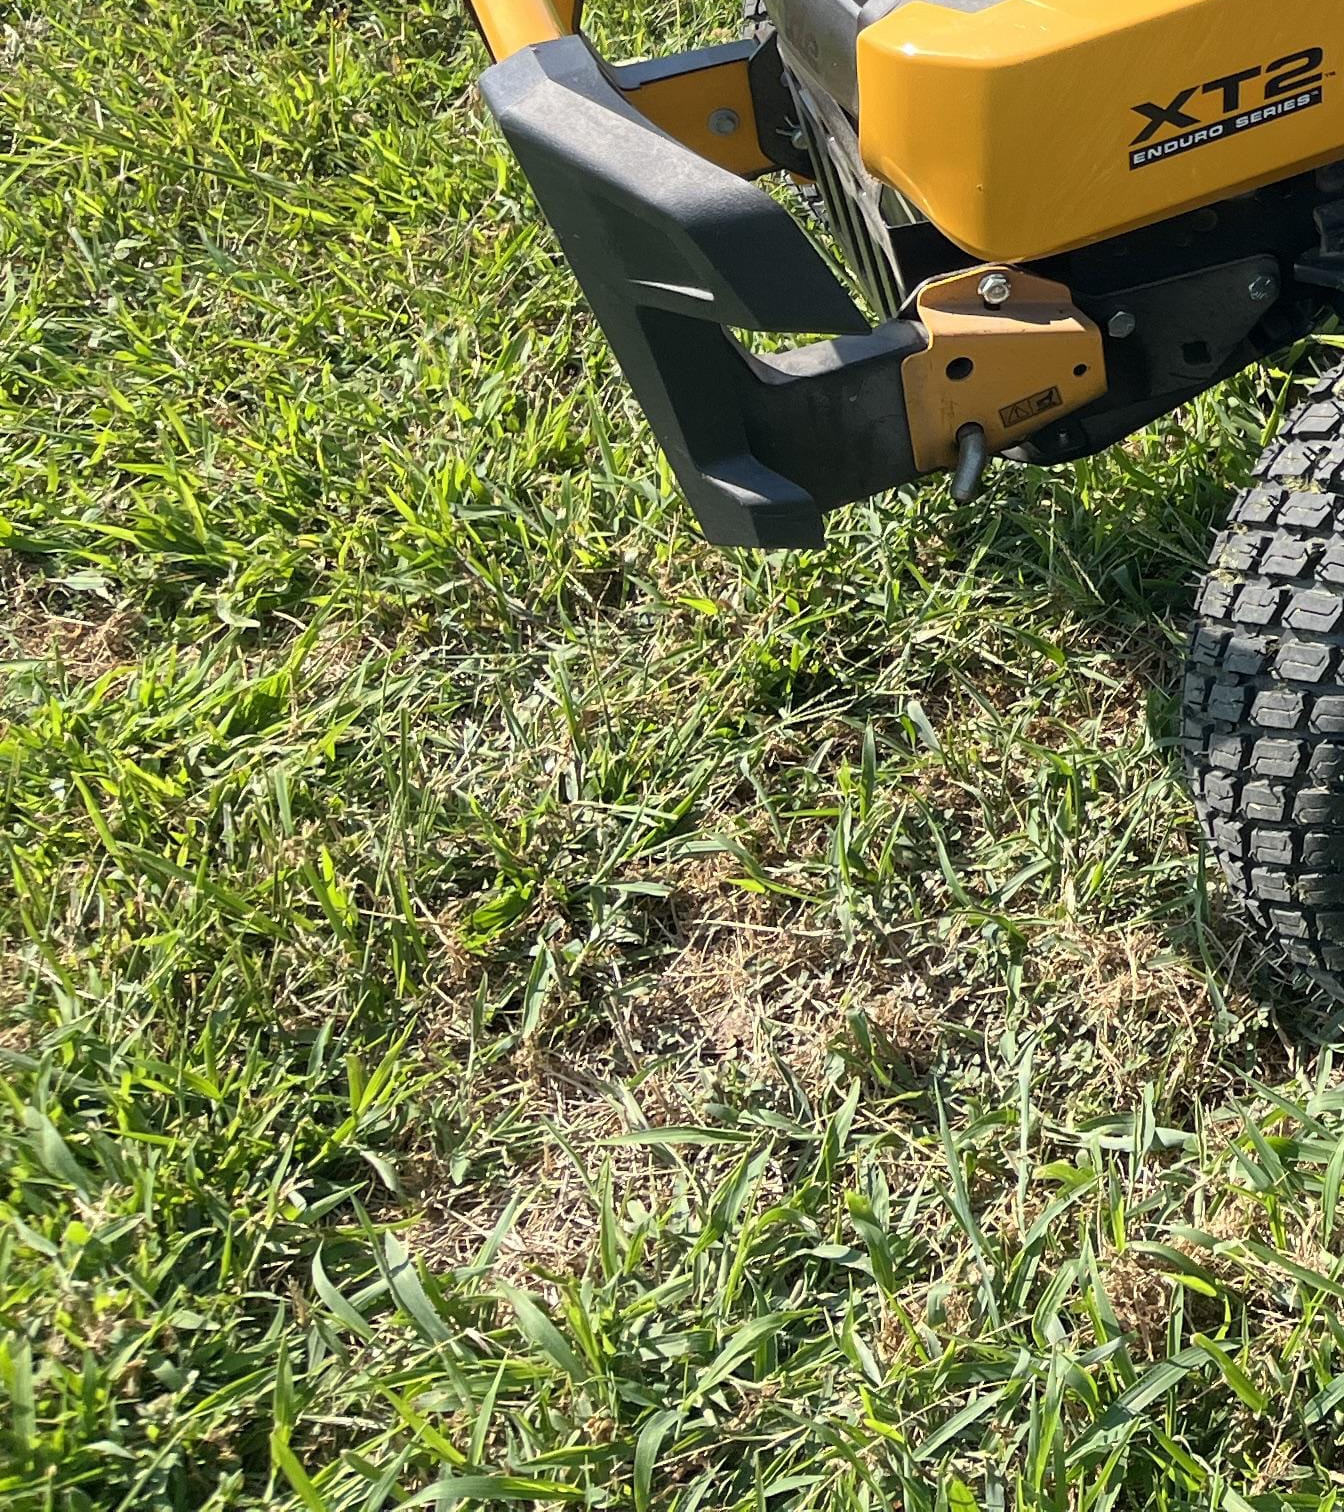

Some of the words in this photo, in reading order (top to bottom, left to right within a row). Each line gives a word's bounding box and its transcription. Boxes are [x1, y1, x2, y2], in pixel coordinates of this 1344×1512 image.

[1128, 46, 1324, 147] XT2
[1132, 124, 1224, 165] ENDURO
[1235, 93, 1311, 129] SERIES
